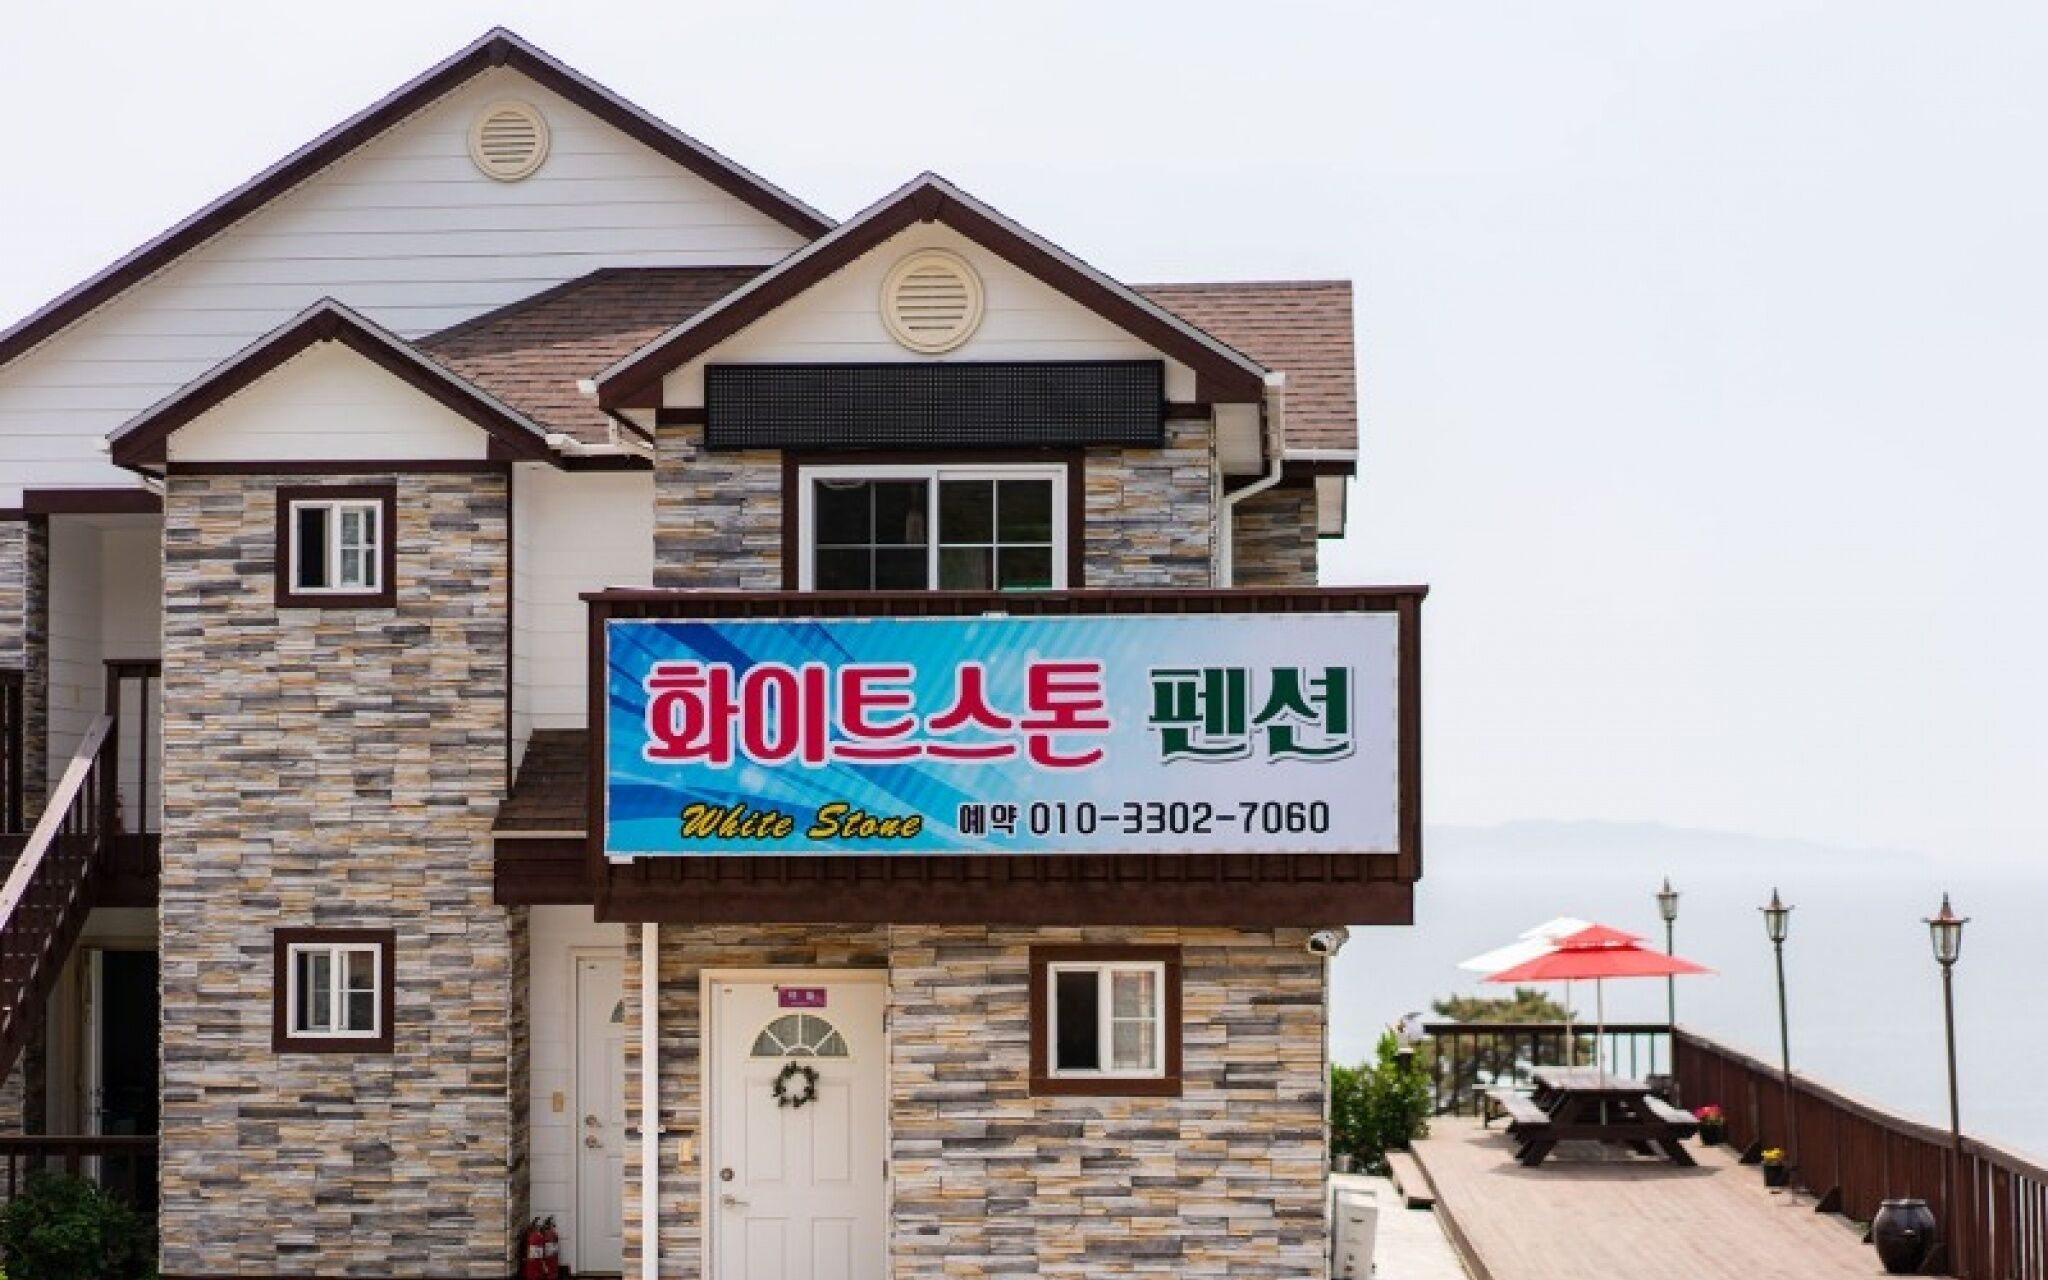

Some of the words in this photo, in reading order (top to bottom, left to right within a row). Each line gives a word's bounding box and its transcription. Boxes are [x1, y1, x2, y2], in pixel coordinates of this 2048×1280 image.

[645, 662, 1112, 766] 화이트스톤
[1147, 666, 1356, 764] 펜션
[680, 802, 793, 840] White
[806, 802, 924, 840] Stone
[958, 804, 1017, 836] 예약
[1029, 801, 1330, 835] 010-3302-7060
